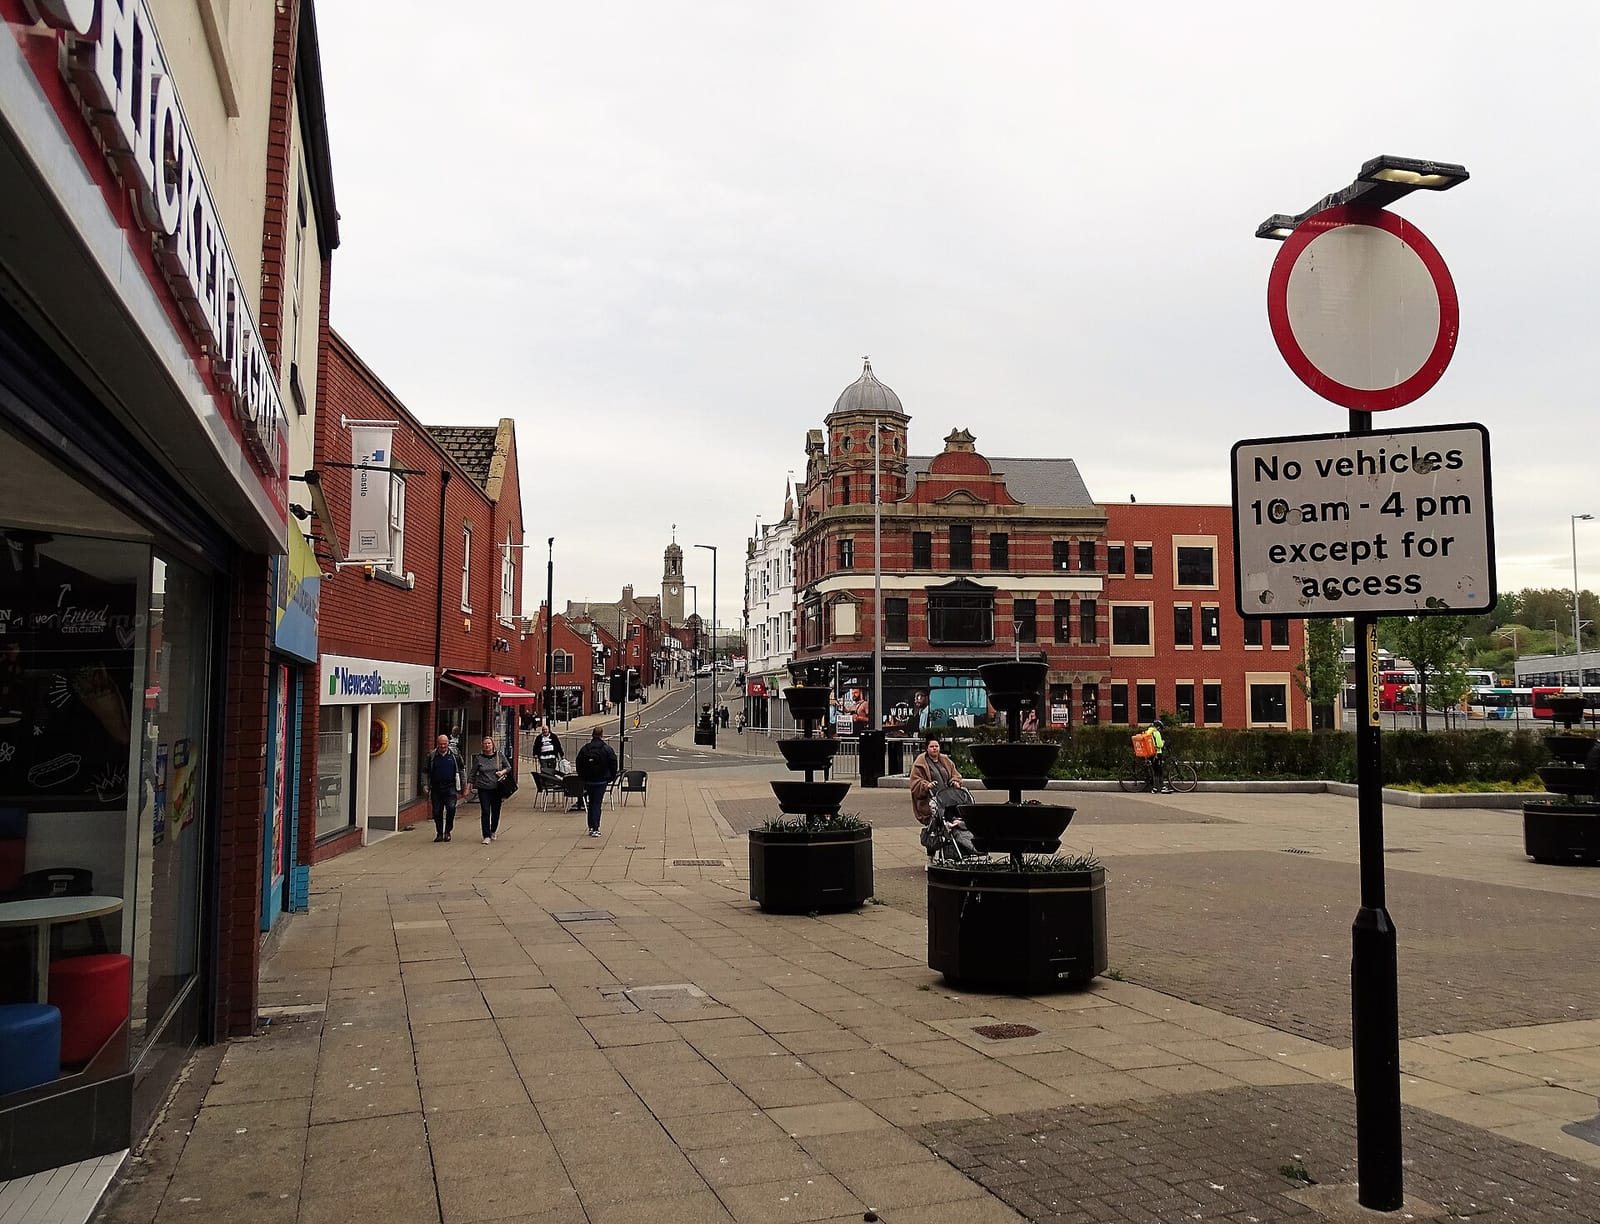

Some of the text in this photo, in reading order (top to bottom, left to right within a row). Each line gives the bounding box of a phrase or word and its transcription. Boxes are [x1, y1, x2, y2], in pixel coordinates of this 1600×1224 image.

[64, 0, 228, 361] HICKEN
[360, 455, 370, 497] Necastle
[1254, 446, 1464, 482] No vehicles
[1251, 498, 1290, 525] 10
[1299, 501, 1350, 522] am
[1380, 491, 1405, 518] 4
[1416, 494, 1472, 522] pm
[1268, 531, 1455, 565] except for
[1301, 573, 1423, 598] access
[61, 626, 105, 634] CHICKEN
[341, 667, 382, 696] Newcastle
[890, 707, 968, 717] WORK LIVE
